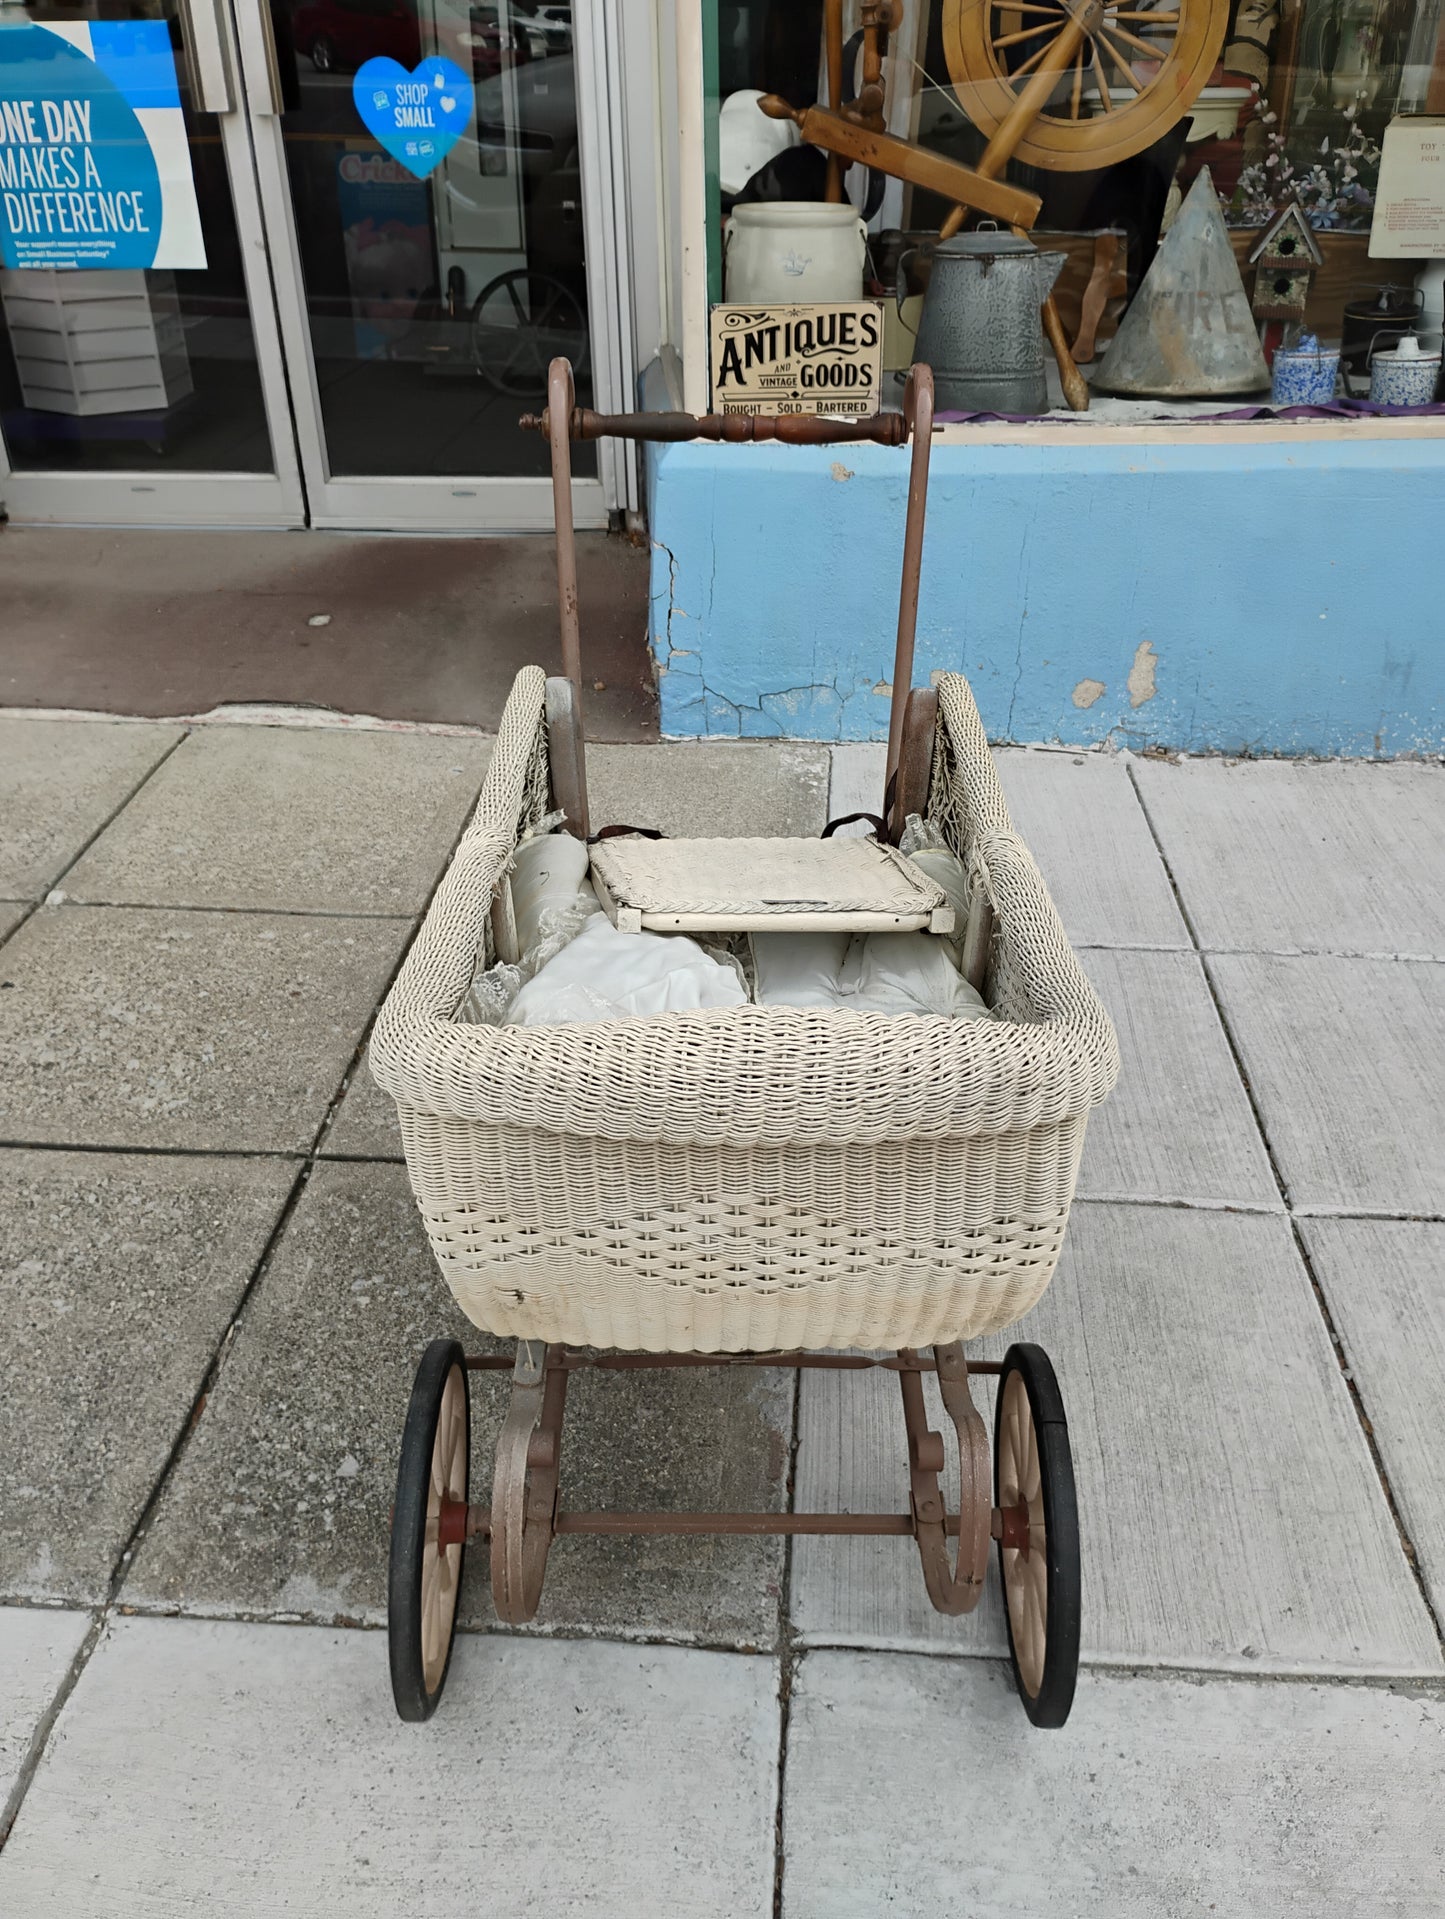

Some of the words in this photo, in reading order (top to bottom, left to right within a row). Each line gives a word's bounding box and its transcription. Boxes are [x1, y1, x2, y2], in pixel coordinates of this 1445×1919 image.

[396, 84, 428, 105] SHOP
[41, 100, 92, 143] DAY
[394, 107, 435, 128] SMALL
[0, 146, 80, 189] MAKES
[84, 146, 102, 188] A
[4, 191, 150, 233] DIFFERENCE
[716, 312, 878, 388] ANTIQUES
[760, 377, 797, 386] VINTAGE
[801, 363, 872, 387] GOODS
[774, 363, 791, 373] AND
[723, 403, 761, 414] BOUGHT
[777, 402, 802, 413] SOLD
[816, 401, 867, 412] BARTERED
